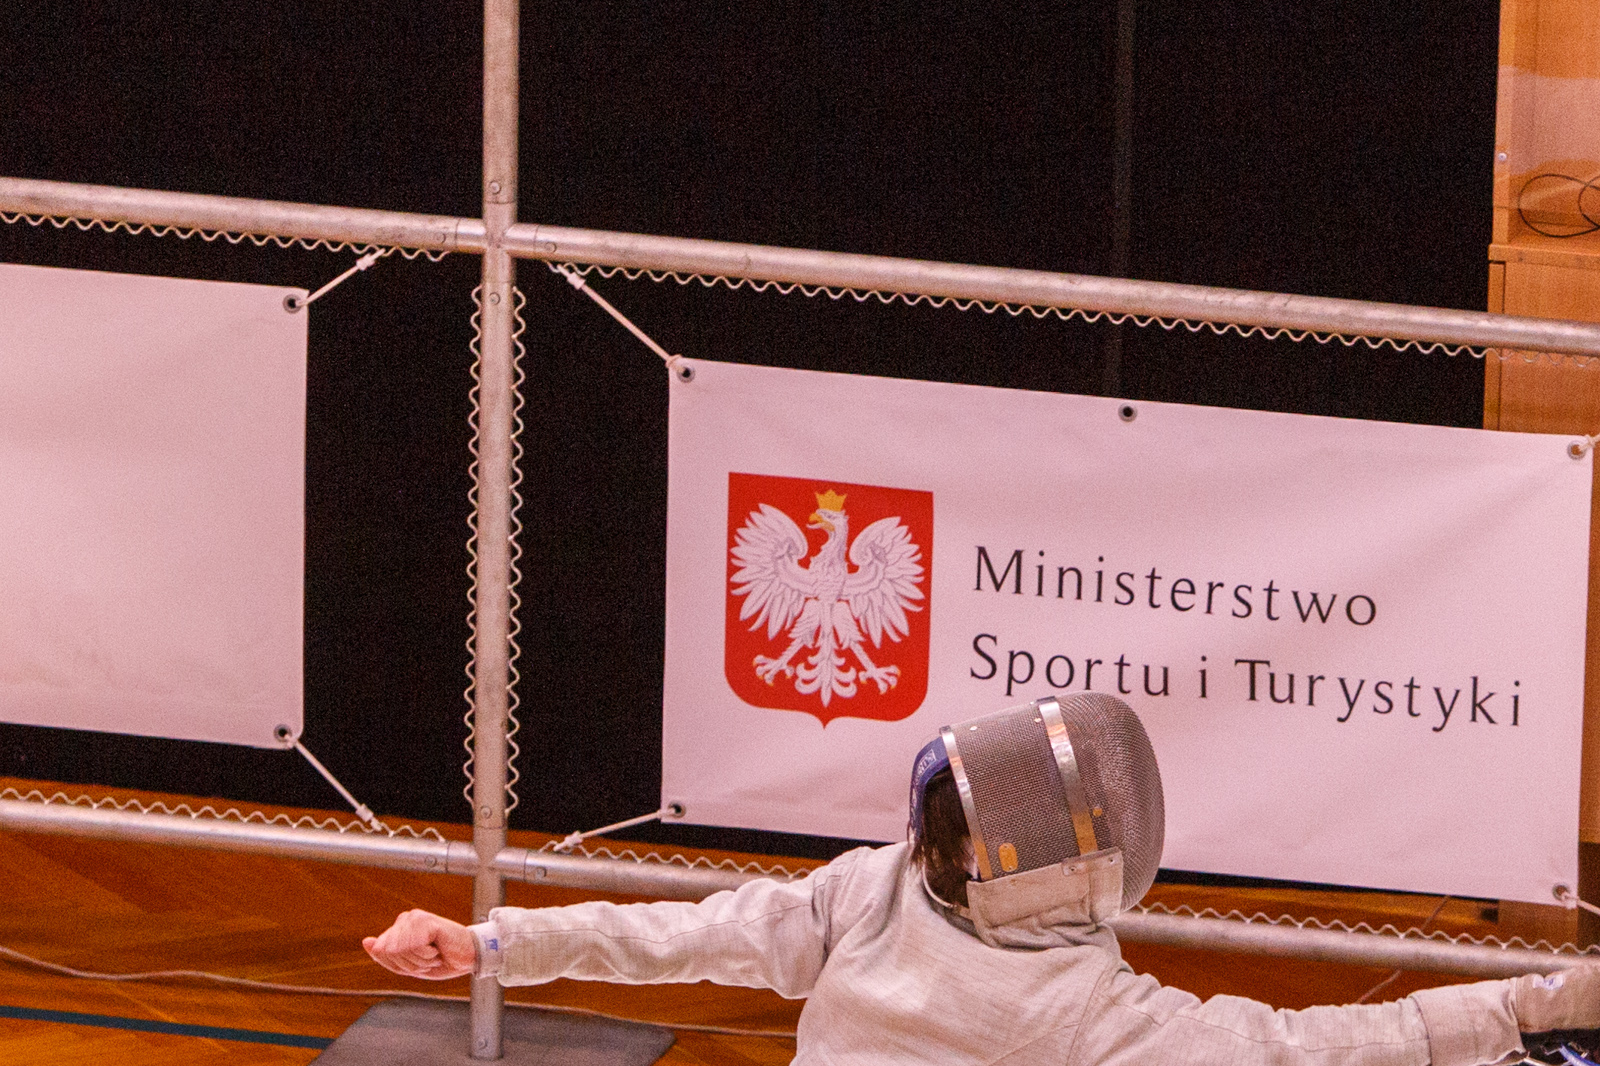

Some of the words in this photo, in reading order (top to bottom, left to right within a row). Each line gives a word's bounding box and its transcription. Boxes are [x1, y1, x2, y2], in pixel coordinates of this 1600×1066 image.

[973, 545, 1377, 626] Ministerstwo
[970, 633, 1171, 697] Sportu
[1198, 656, 1208, 699] i
[1234, 659, 1521, 733] Turystyki
